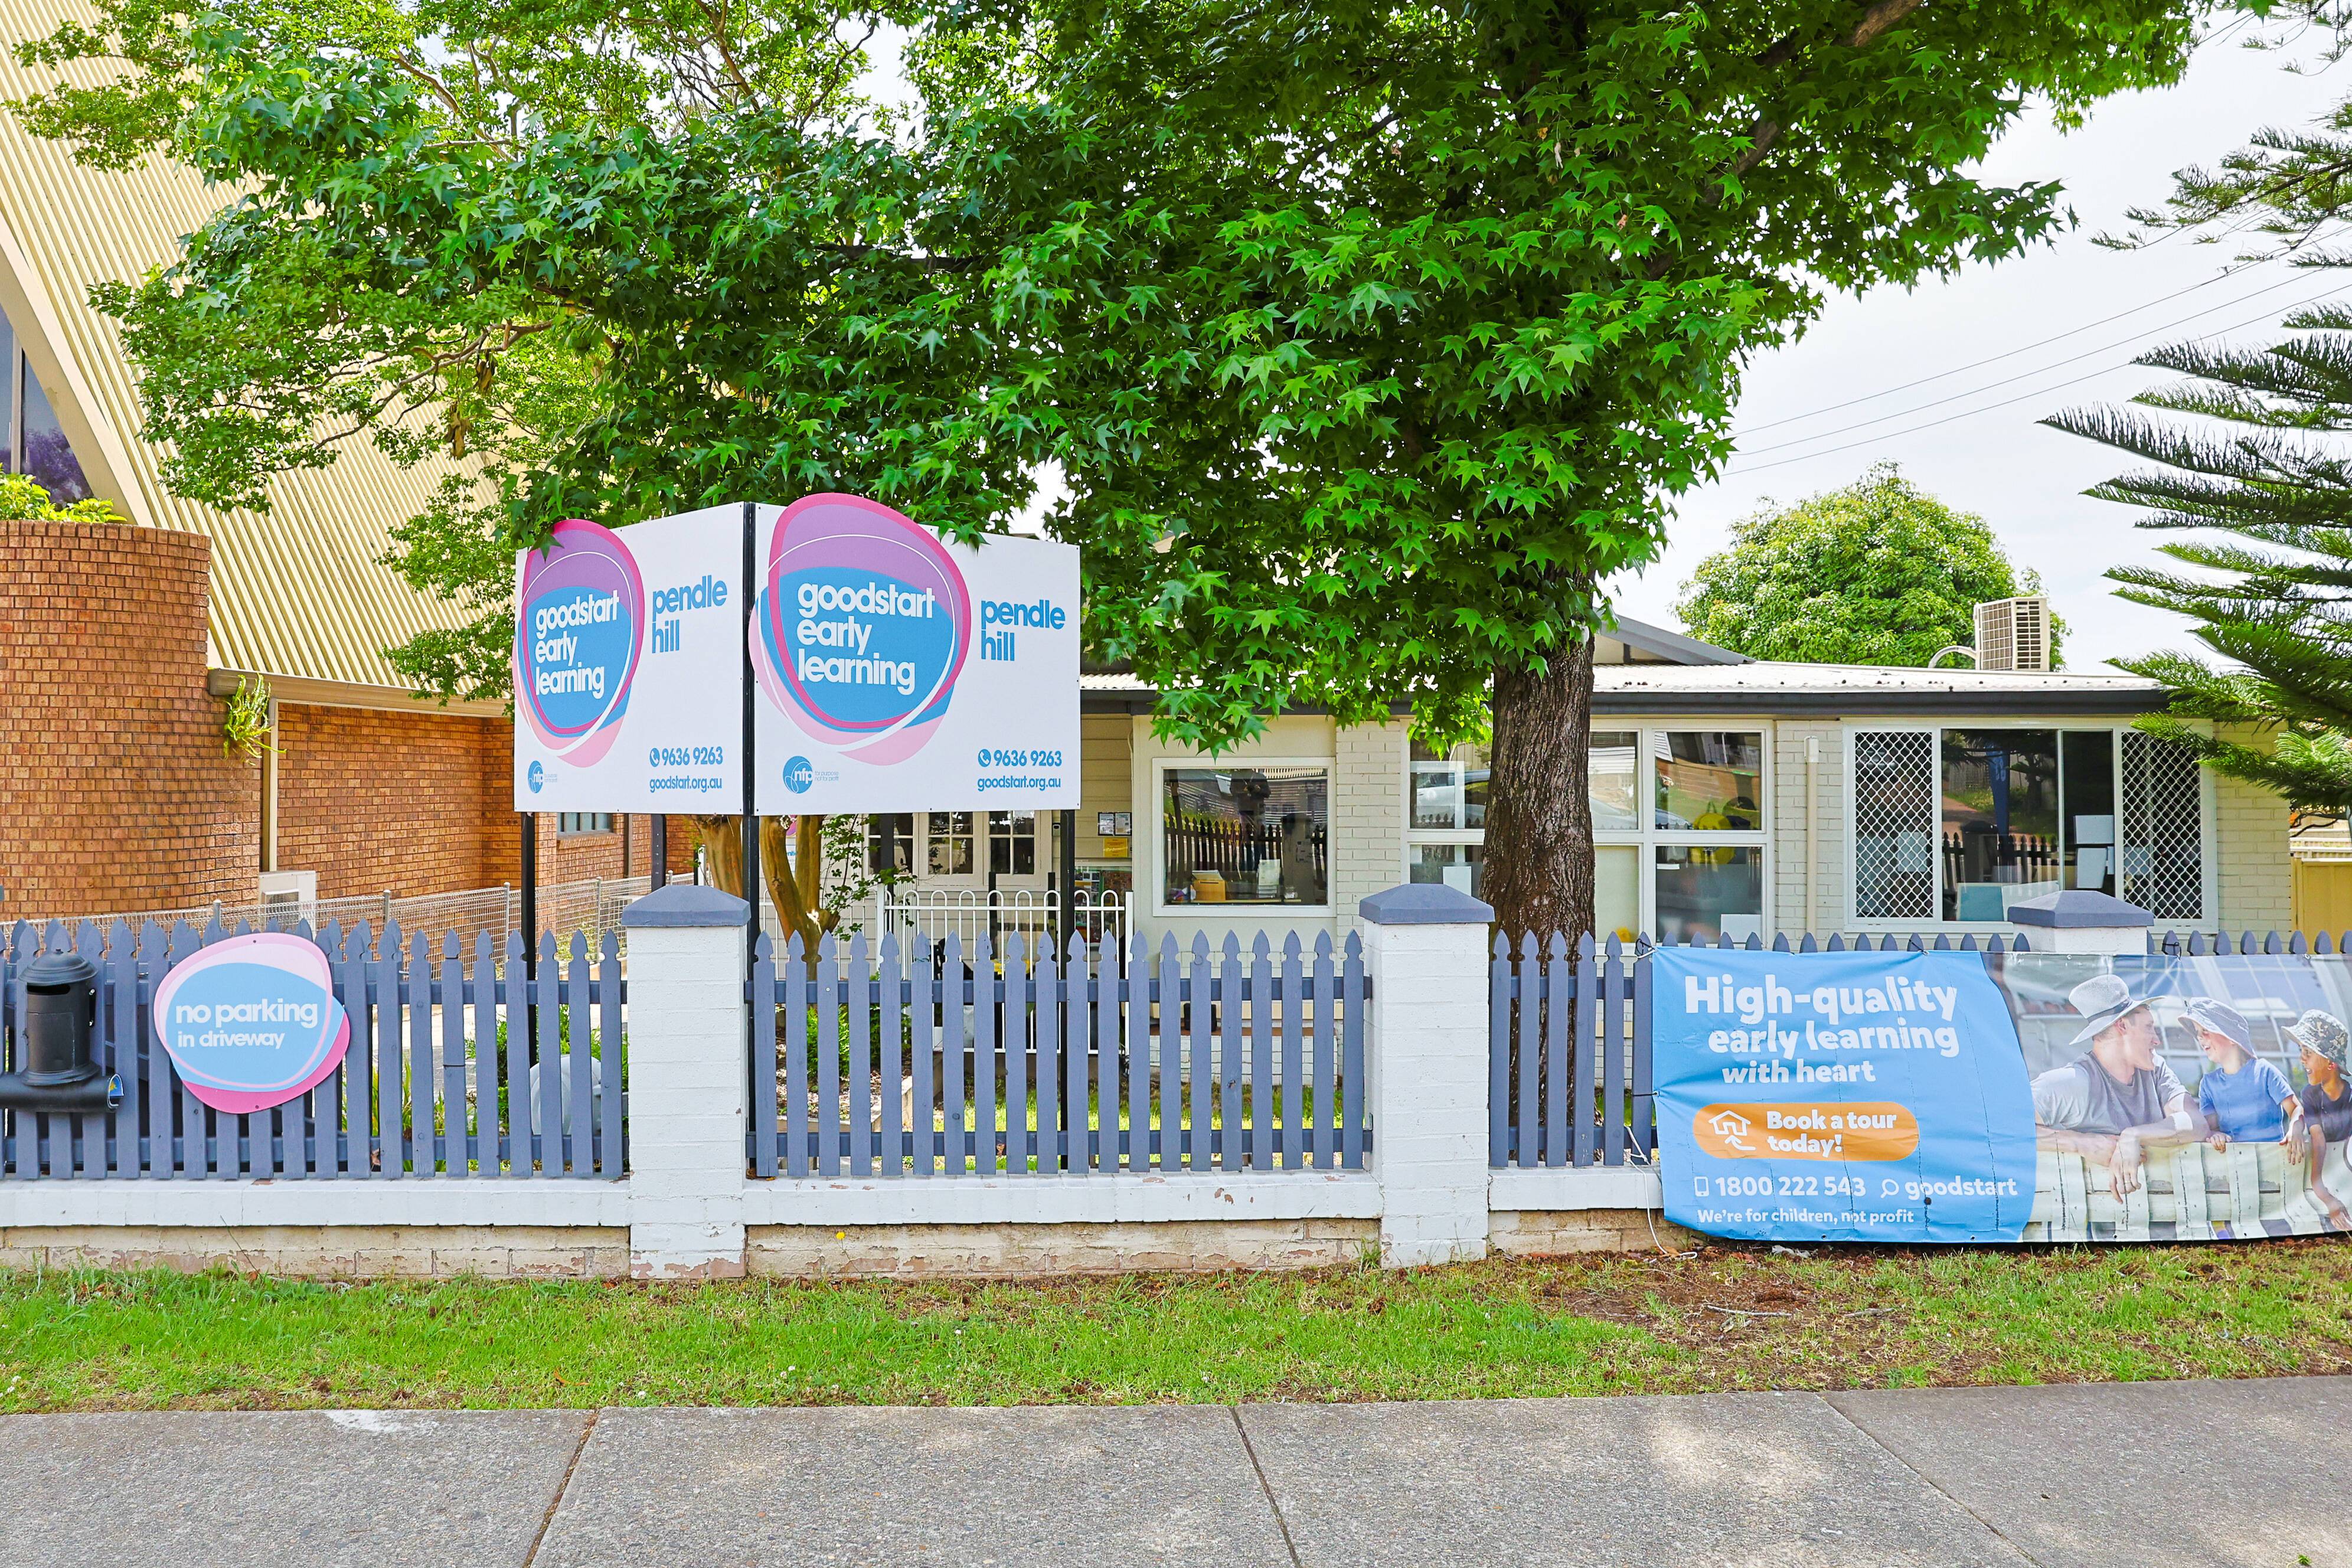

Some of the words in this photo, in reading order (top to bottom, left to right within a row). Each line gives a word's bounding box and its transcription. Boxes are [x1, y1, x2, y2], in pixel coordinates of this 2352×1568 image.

[652, 575, 727, 621] pendle
[798, 582, 935, 619] goodstart
[535, 590, 619, 638] goodstart
[981, 599, 1066, 630] pendle
[535, 631, 577, 665] early
[652, 619, 680, 654] hill
[797, 615, 873, 655] early
[981, 631, 1015, 662] hill
[535, 662, 605, 699] learning
[798, 648, 915, 695] learning
[662, 747, 690, 766] 9636
[693, 746, 723, 765] 9263
[994, 750, 1027, 766] 9636
[1030, 750, 1062, 767] 9263
[649, 775, 722, 793] goodstart.org.au
[794, 767, 812, 784] nfp
[978, 775, 1061, 792] goodstart.org.au
[175, 1005, 211, 1024] no
[215, 998, 318, 1029] parking
[1685, 974, 1957, 1026] High-quality
[178, 1031, 194, 1048] in
[198, 1030, 285, 1050] driveway
[1709, 1020, 1799, 1059] early
[1806, 1020, 1959, 1057] learning
[1723, 1059, 1789, 1083] with
[1796, 1060, 1876, 1083] heart
[1767, 1109, 1828, 1130] Book
[1831, 1115, 1844, 1130] a
[1847, 1112, 1897, 1129] tour
[1767, 1135, 1843, 1158] today!
[1716, 1177, 1773, 1197] 1800
[1779, 1177, 1818, 1196] 222
[1824, 1177, 1866, 1197] 543
[1905, 1175, 2018, 1201] goodstart
[1746, 1208, 1768, 1223] for
[1771, 1207, 1838, 1225] children,
[1841, 1210, 1866, 1224] not
[1870, 1207, 1914, 1226] profit
